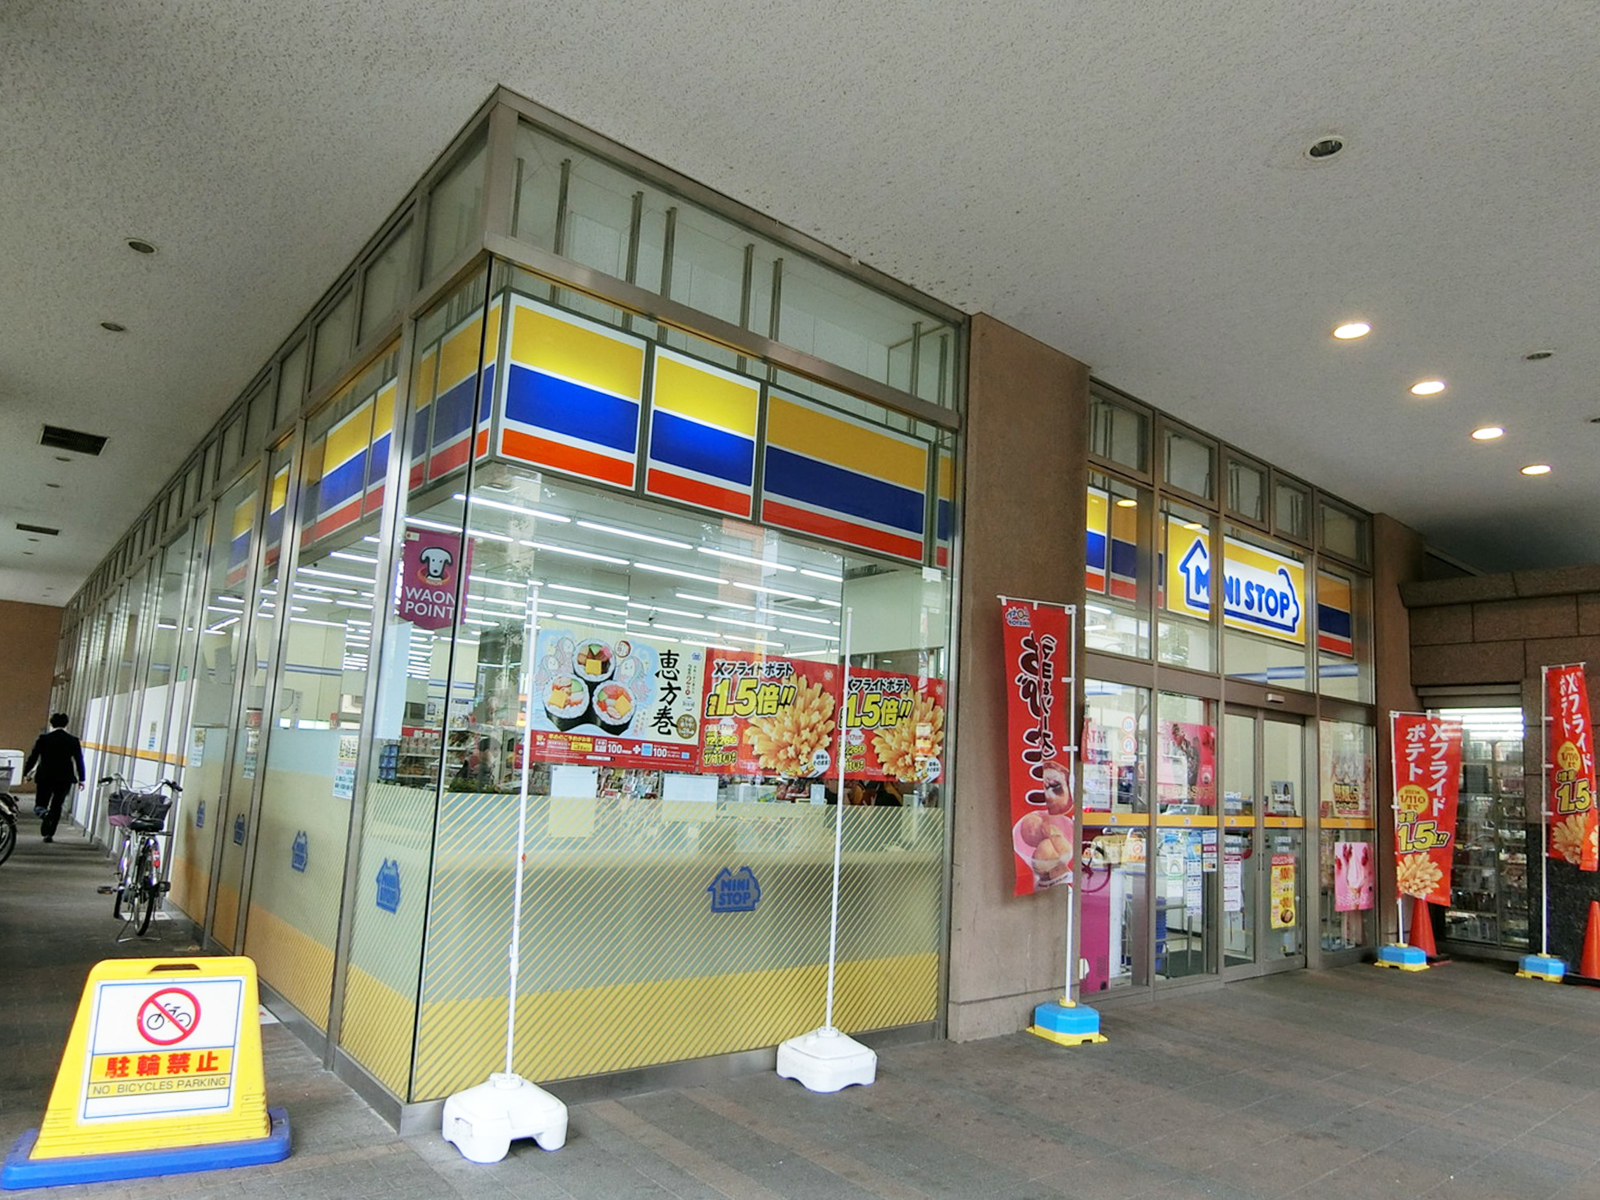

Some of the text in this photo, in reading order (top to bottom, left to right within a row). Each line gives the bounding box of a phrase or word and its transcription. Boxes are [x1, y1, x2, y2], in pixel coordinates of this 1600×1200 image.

[405, 586, 455, 605] WAON
[1195, 564, 1290, 619] MNI STOP
[404, 600, 455, 620] POINT
[650, 649, 682, 736] 恵方巻
[1565, 672, 1593, 775] Xフライド
[1405, 724, 1427, 782] ポテト
[1428, 724, 1450, 817] Xフライド
[718, 891, 751, 906] STOP
[720, 878, 750, 892] MINI
[105, 1050, 219, 1079] 駐輪禁止
[93, 1076, 226, 1095] NO BICYCLES PARKING
